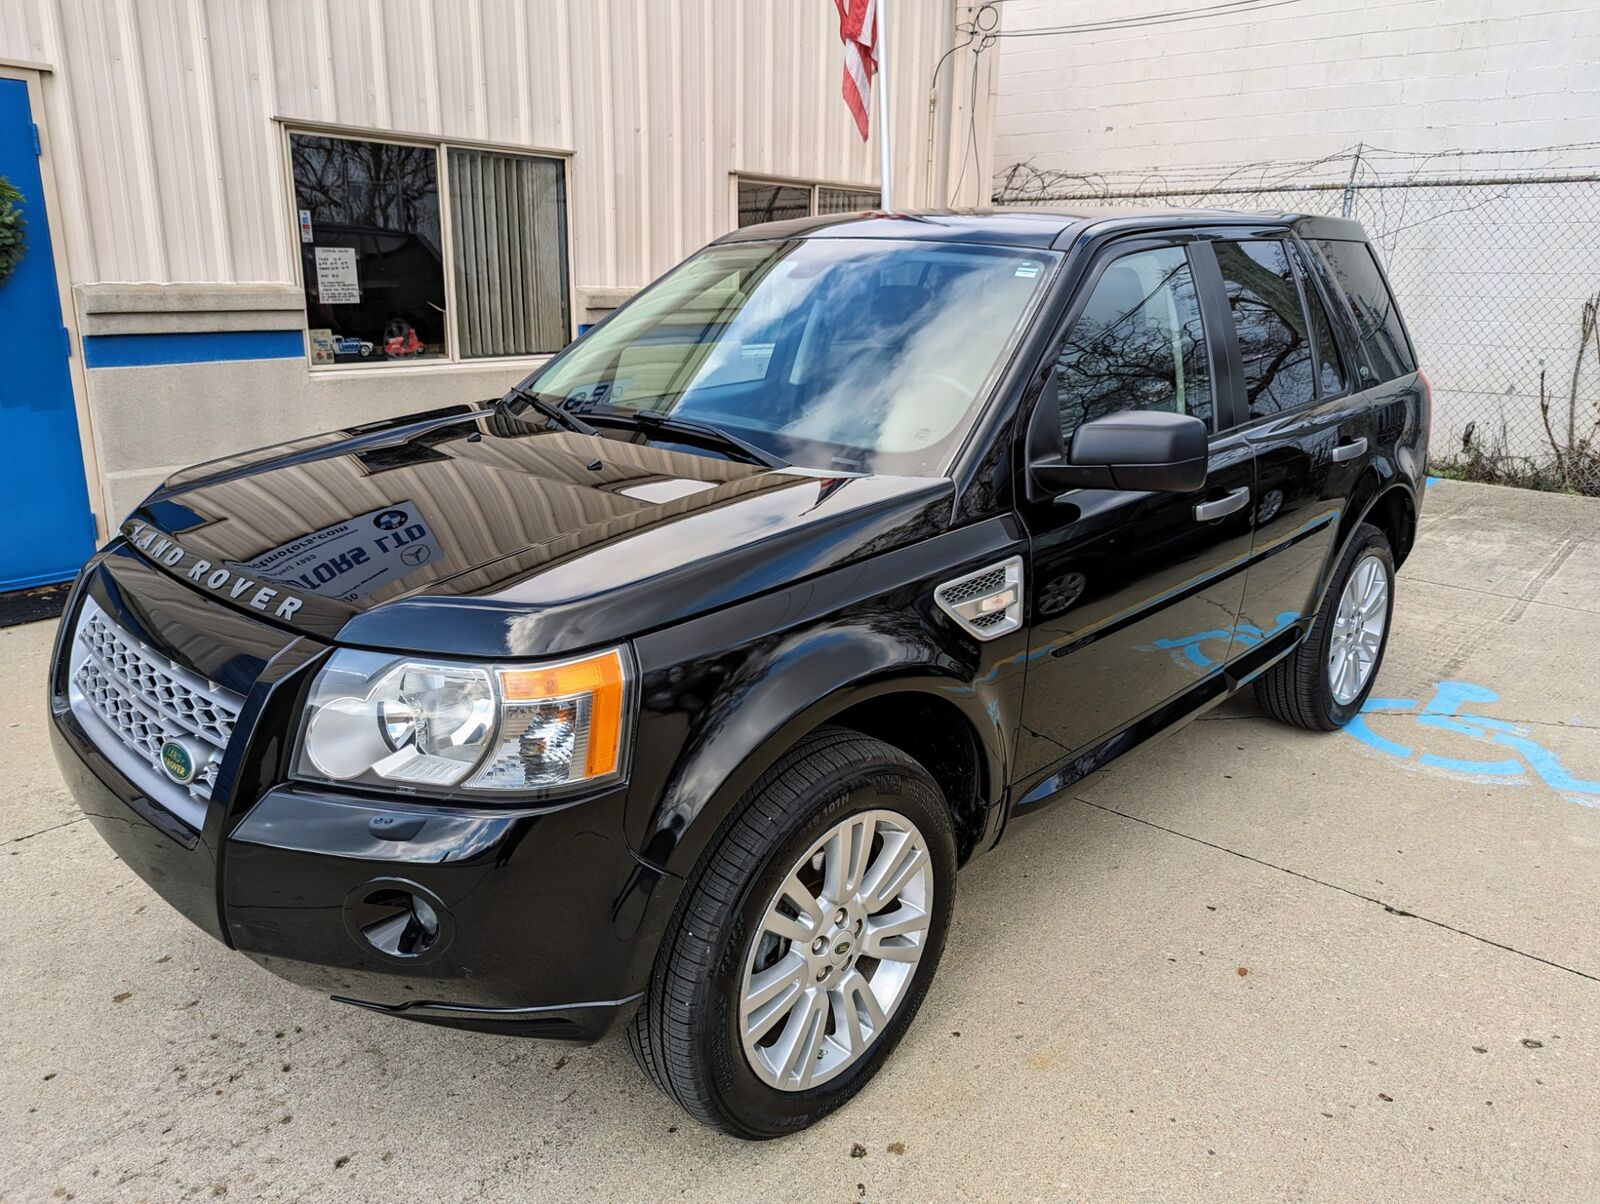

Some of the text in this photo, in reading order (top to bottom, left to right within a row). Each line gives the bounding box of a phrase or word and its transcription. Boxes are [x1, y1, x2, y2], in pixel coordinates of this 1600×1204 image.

[129, 523, 303, 621] LAND ROVER
[822, 792, 850, 817] 101H
